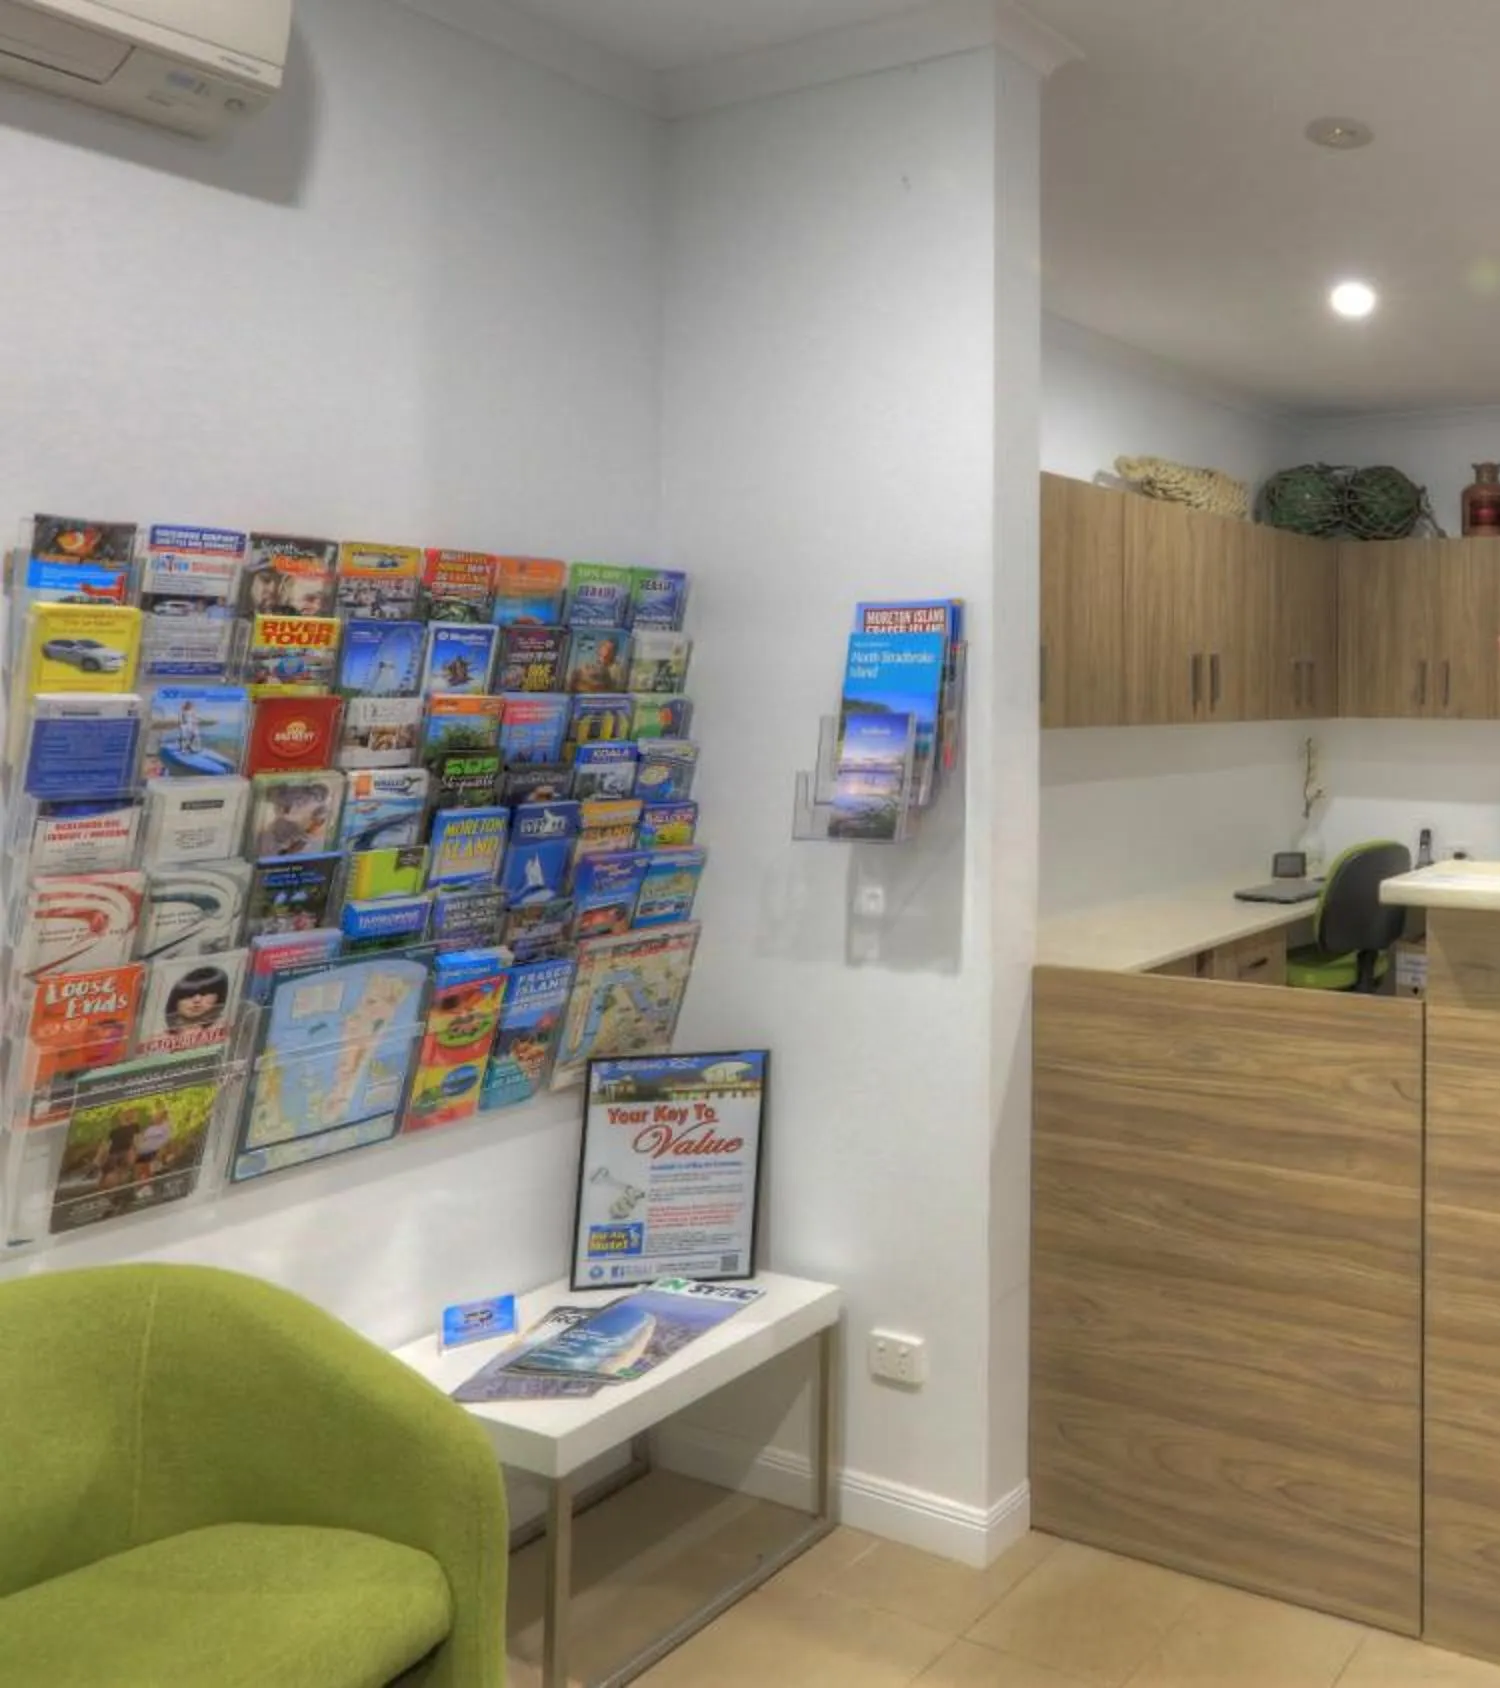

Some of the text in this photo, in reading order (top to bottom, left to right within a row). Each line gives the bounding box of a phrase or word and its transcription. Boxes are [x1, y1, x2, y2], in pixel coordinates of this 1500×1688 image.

[262, 621, 335, 636] RIVER
[264, 633, 332, 647] TOUR
[607, 1103, 715, 1126] Your Key To
[632, 1119, 745, 1160] Value
